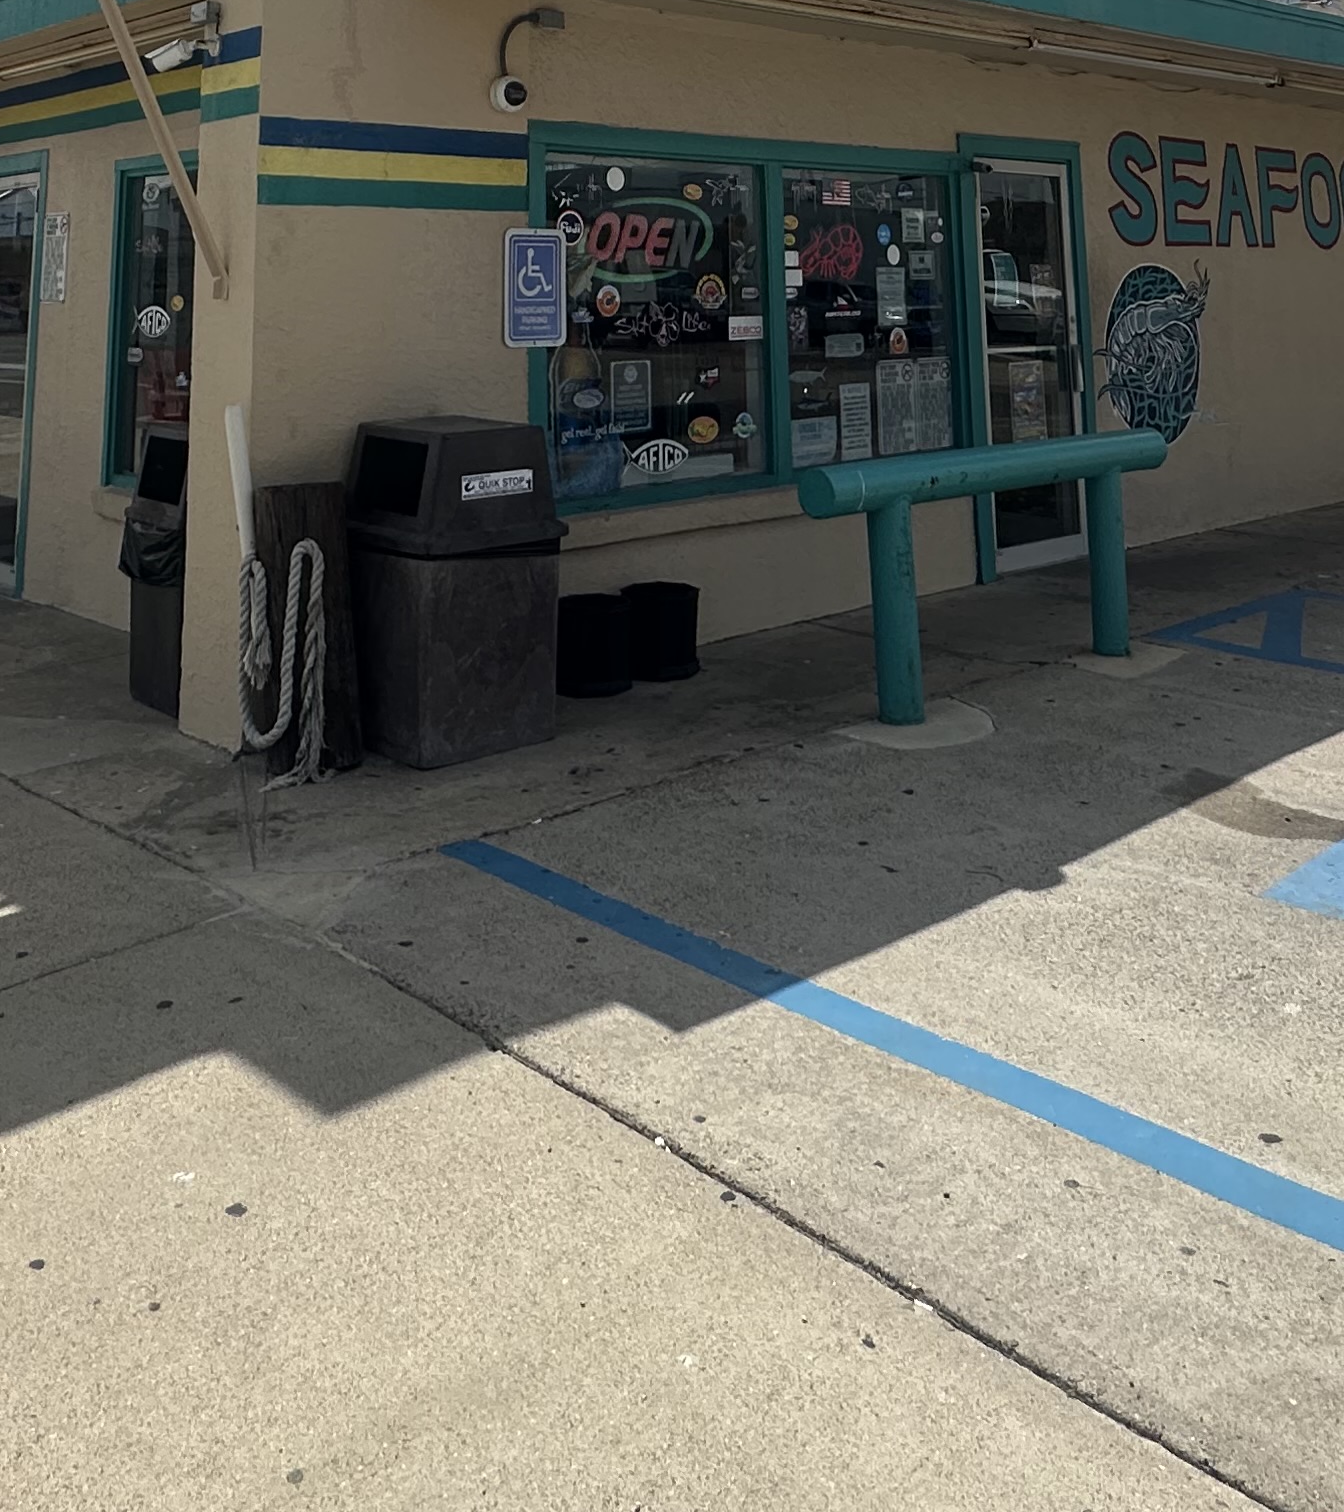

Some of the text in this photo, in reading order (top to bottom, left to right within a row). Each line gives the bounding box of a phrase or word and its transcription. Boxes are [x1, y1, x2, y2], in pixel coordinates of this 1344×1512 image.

[586, 211, 700, 269] OPEN
[140, 308, 168, 336] AFTCO
[730, 326, 762, 336] ZEBCO
[637, 441, 683, 473] AFTCO
[478, 478, 501, 490] QUIK
[502, 476, 525, 488] STOP
